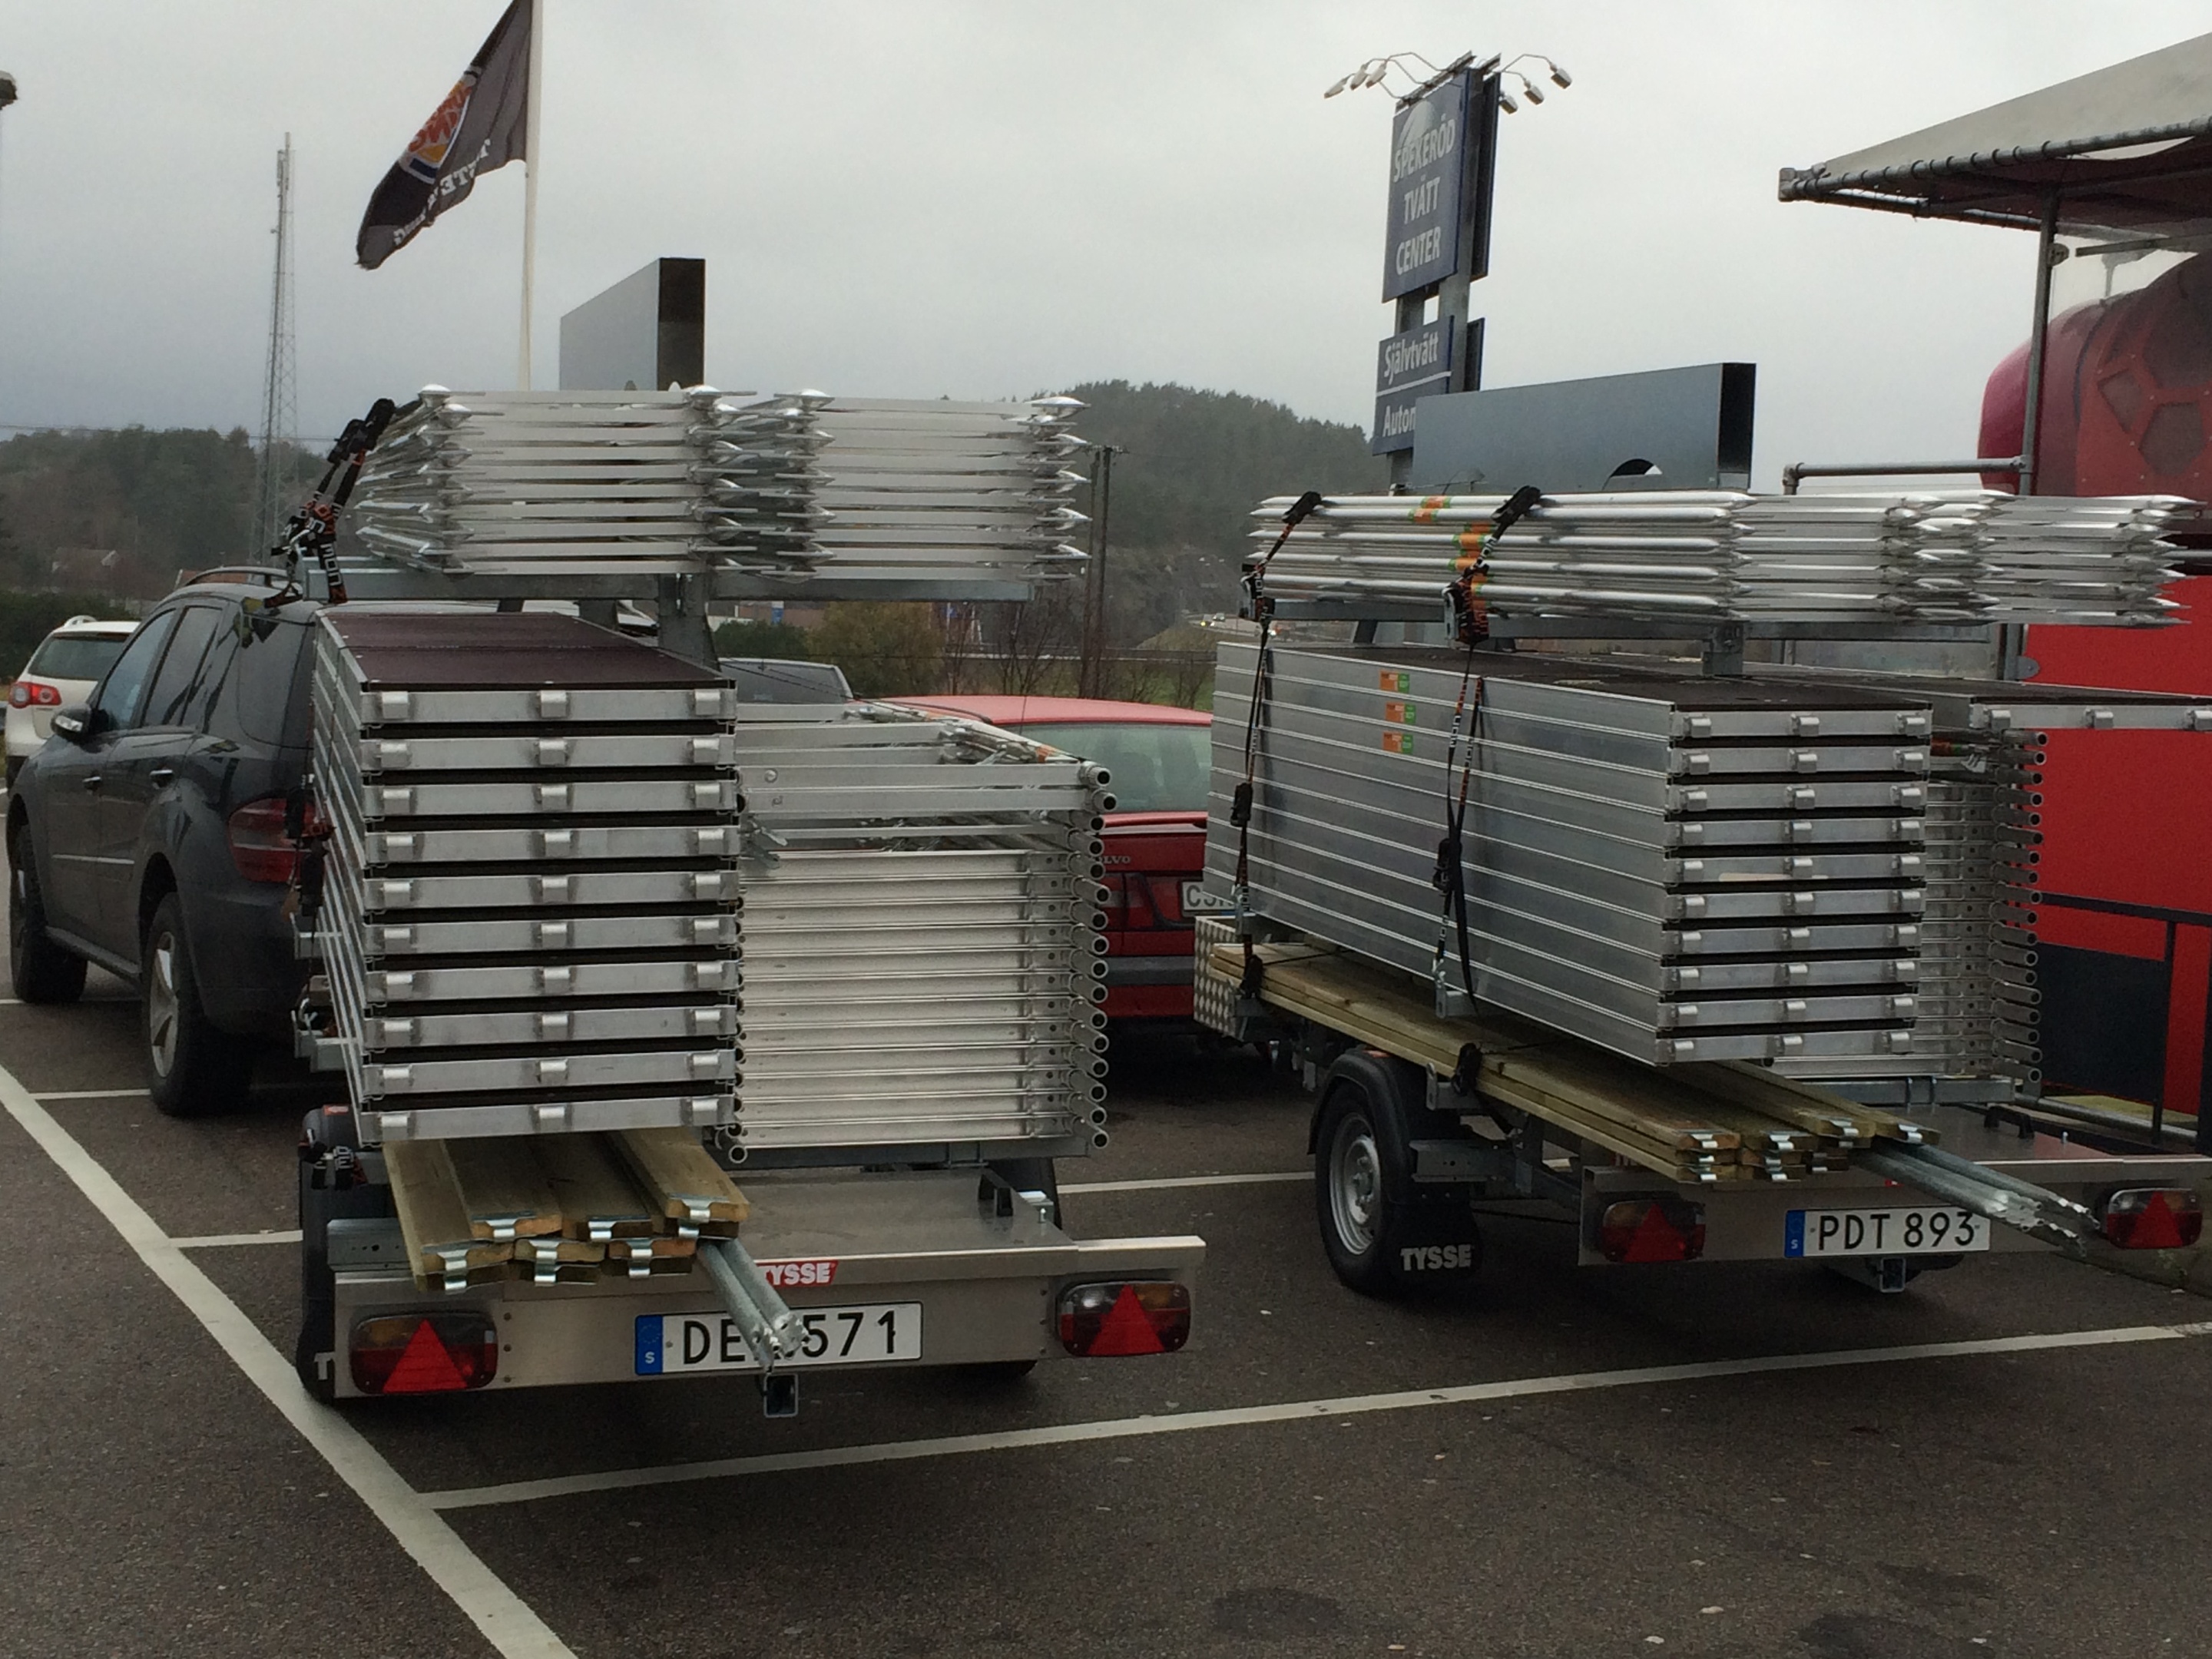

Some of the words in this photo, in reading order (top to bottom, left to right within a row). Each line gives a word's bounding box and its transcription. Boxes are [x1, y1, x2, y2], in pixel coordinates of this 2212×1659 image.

[1393, 113, 1455, 183] SPEKERÖD
[1404, 174, 1441, 225] TVÄTT
[1396, 227, 1441, 276] CENTER
[1383, 331, 1439, 386] Självtvätt
[1818, 1214, 1891, 1250] PDT
[1904, 1211, 1975, 1249] 893
[1400, 1243, 1472, 1271] TYSSE
[802, 1310, 896, 1358] 571
